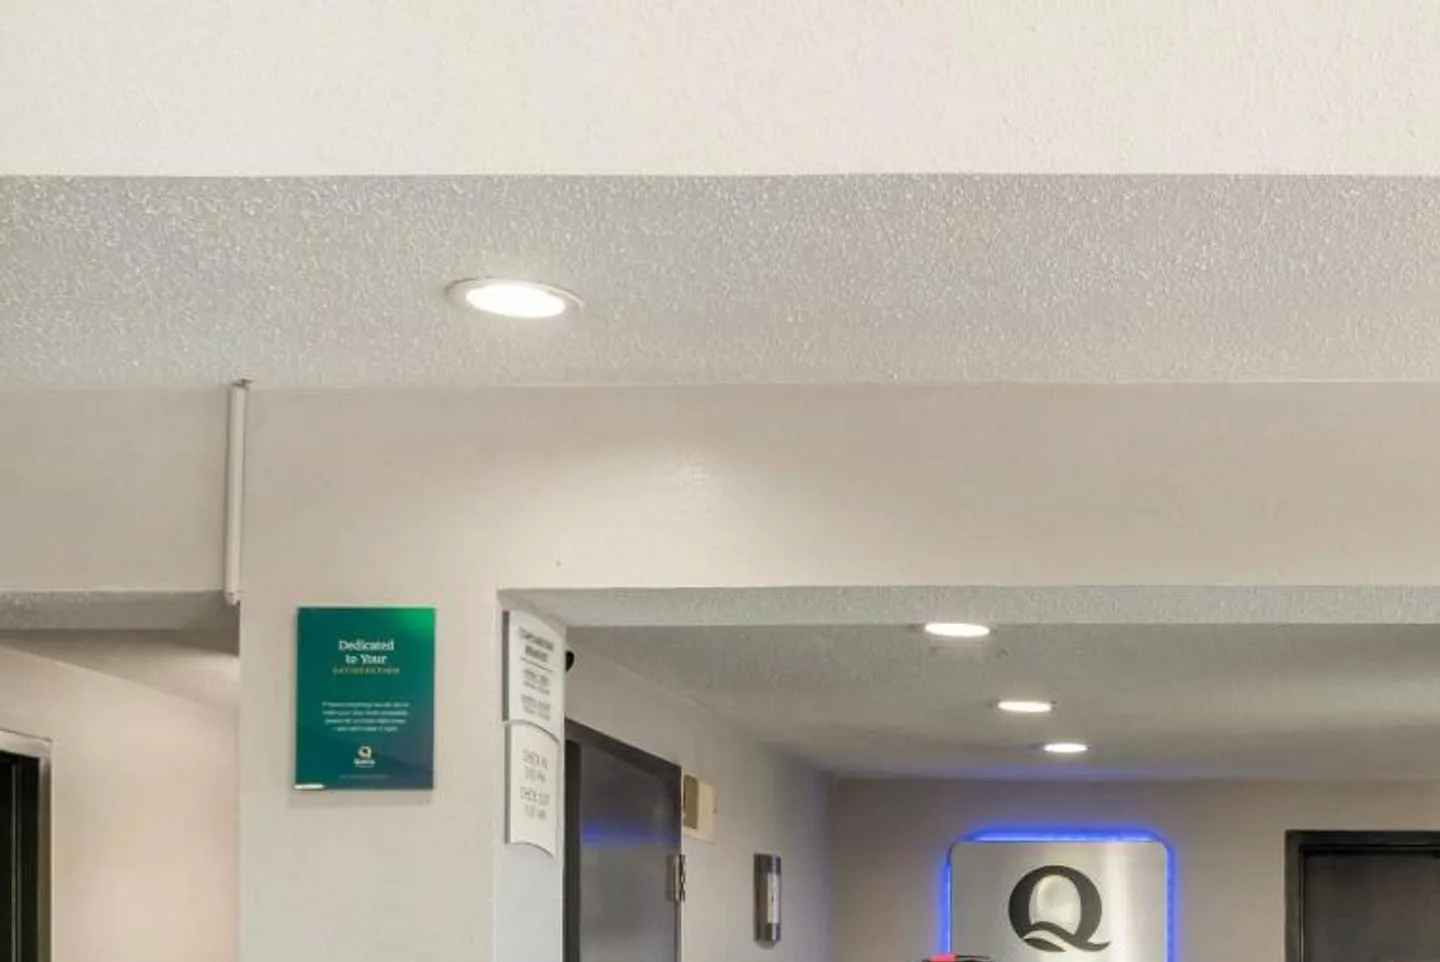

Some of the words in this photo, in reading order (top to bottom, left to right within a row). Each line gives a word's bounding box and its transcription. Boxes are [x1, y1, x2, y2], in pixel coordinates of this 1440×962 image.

[338, 638, 395, 651] Dedicated
[345, 653, 359, 664] to
[360, 653, 388, 664] Your
[1008, 865, 1112, 953] Q
